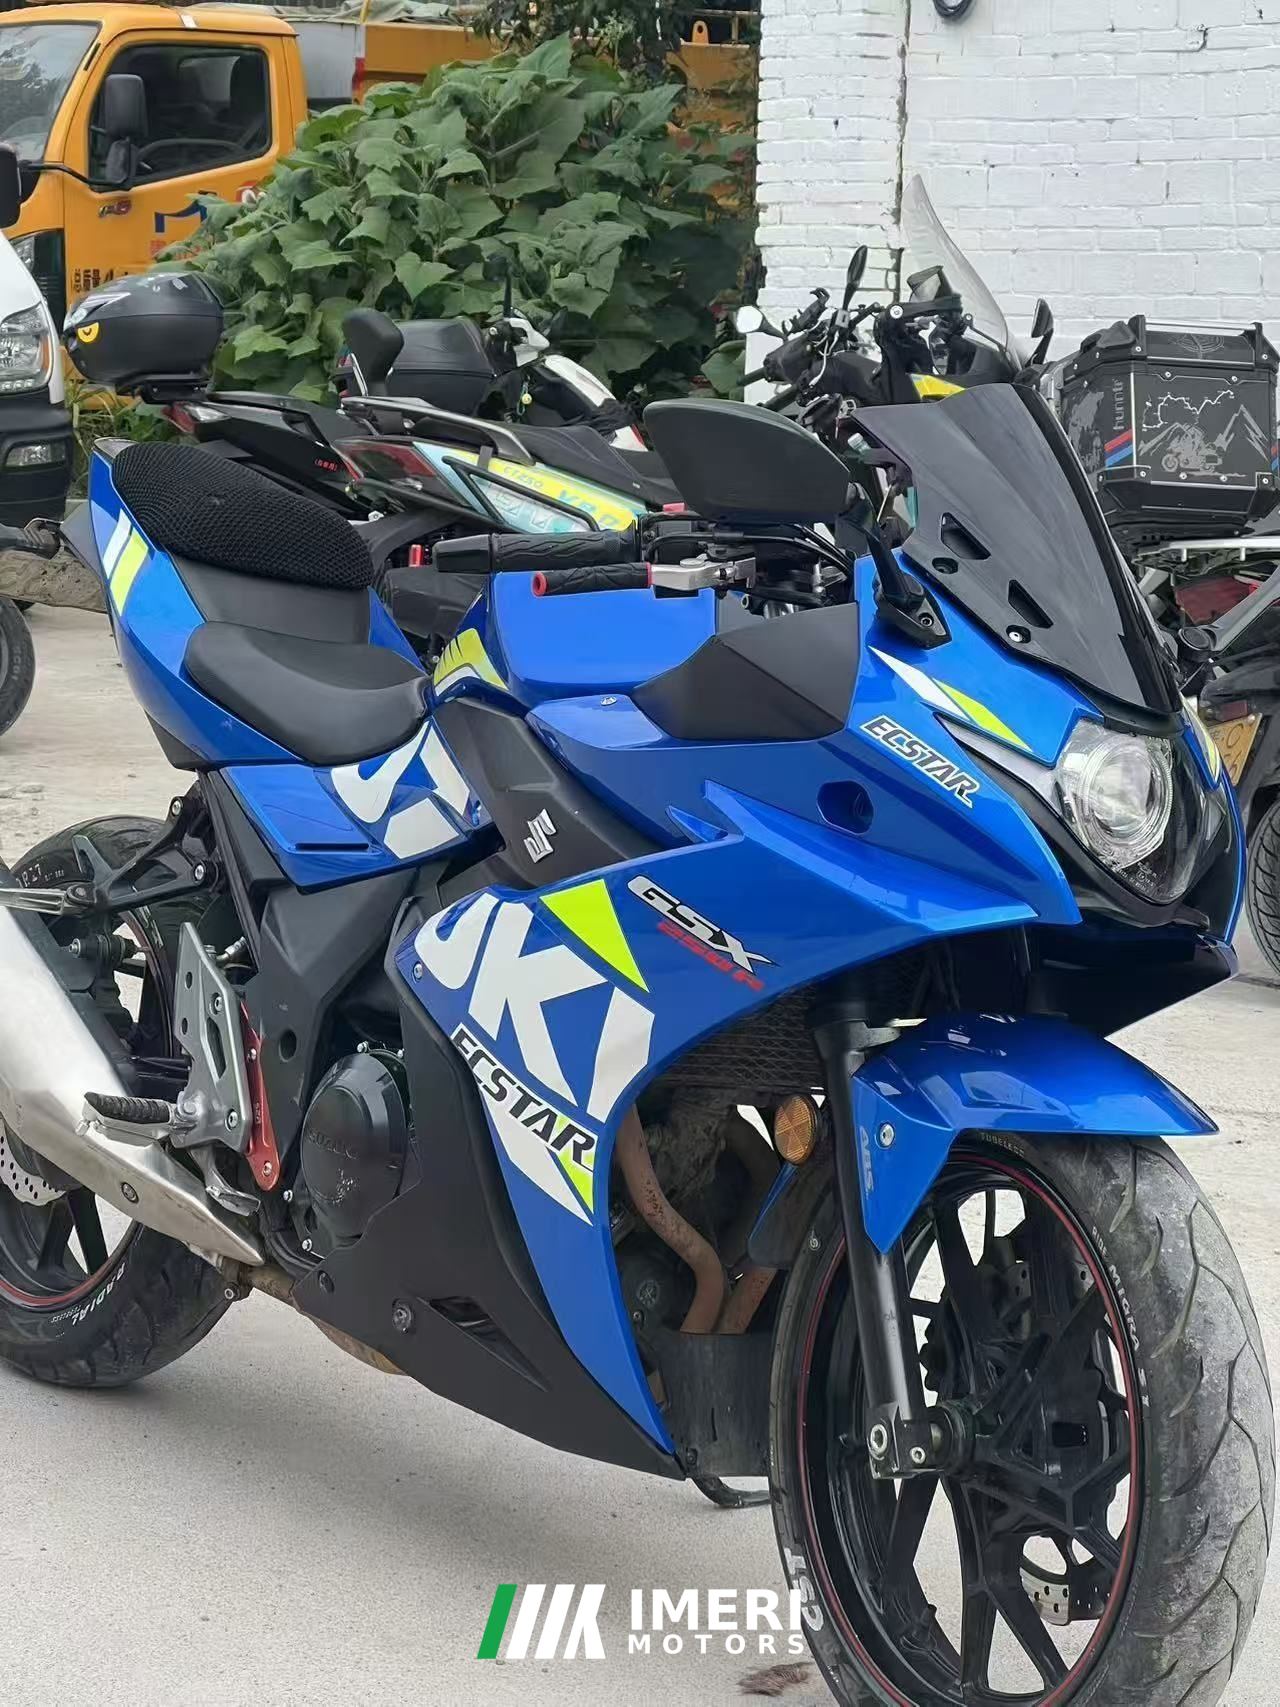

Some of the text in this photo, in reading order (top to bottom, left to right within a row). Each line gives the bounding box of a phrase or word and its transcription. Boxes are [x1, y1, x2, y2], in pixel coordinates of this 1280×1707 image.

[860, 715, 980, 808] ECSTAR
[627, 875, 781, 975] GSX
[451, 1028, 596, 1173] ECSTAR
[72, 1262, 126, 1326] RADIAL
